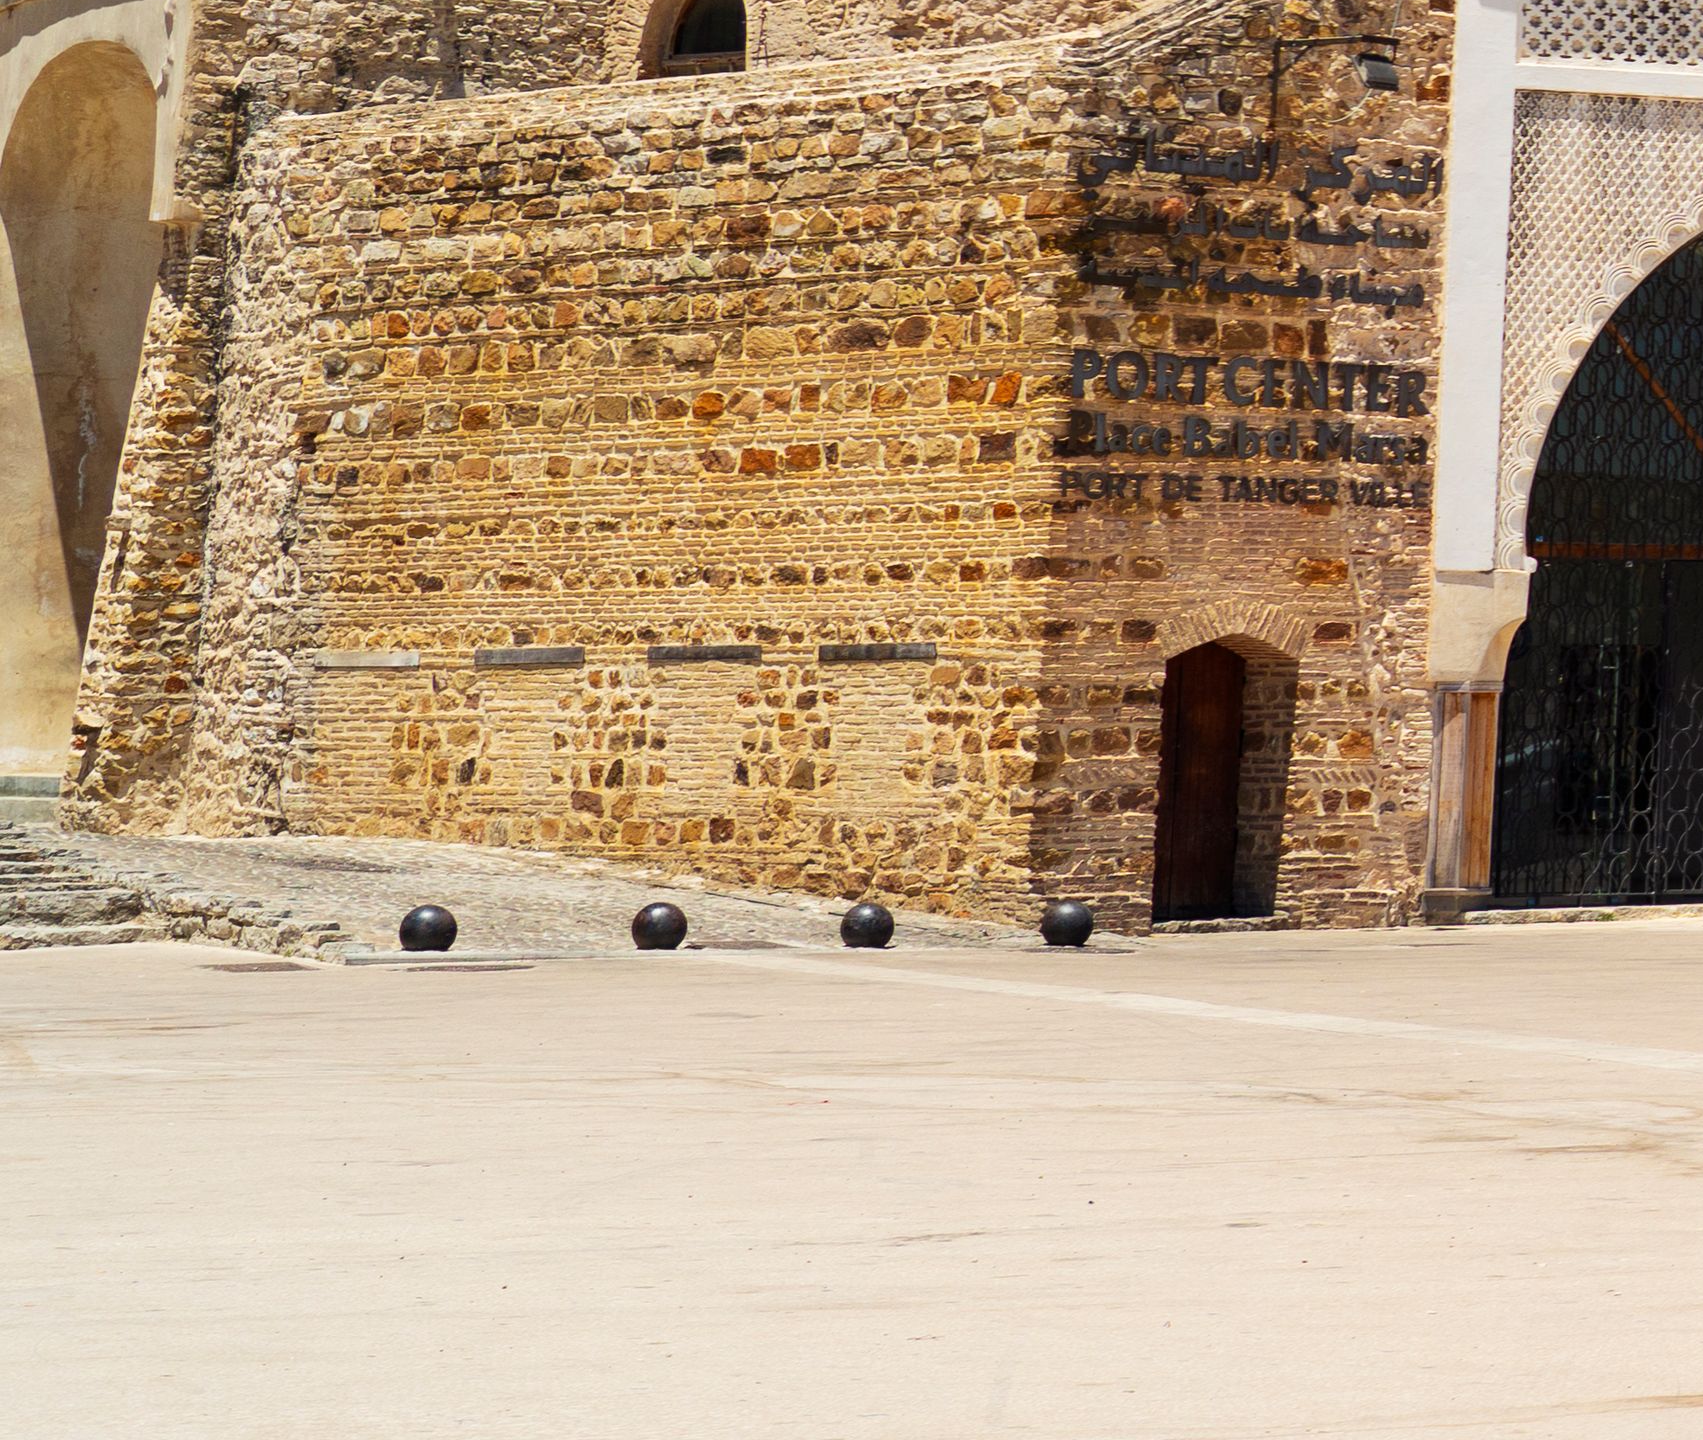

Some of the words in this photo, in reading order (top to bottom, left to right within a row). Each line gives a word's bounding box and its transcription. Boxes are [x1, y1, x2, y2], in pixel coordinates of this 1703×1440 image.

[1071, 348, 1220, 406] PORT
[1223, 355, 1430, 418] CENTER
[1069, 410, 1172, 457] Place
[1314, 419, 1430, 466] Marsa
[1059, 470, 1149, 500] PORT
[1162, 473, 1203, 502] DE
[1217, 475, 1339, 505] TANGER
[1350, 479, 1430, 509] VILLE
